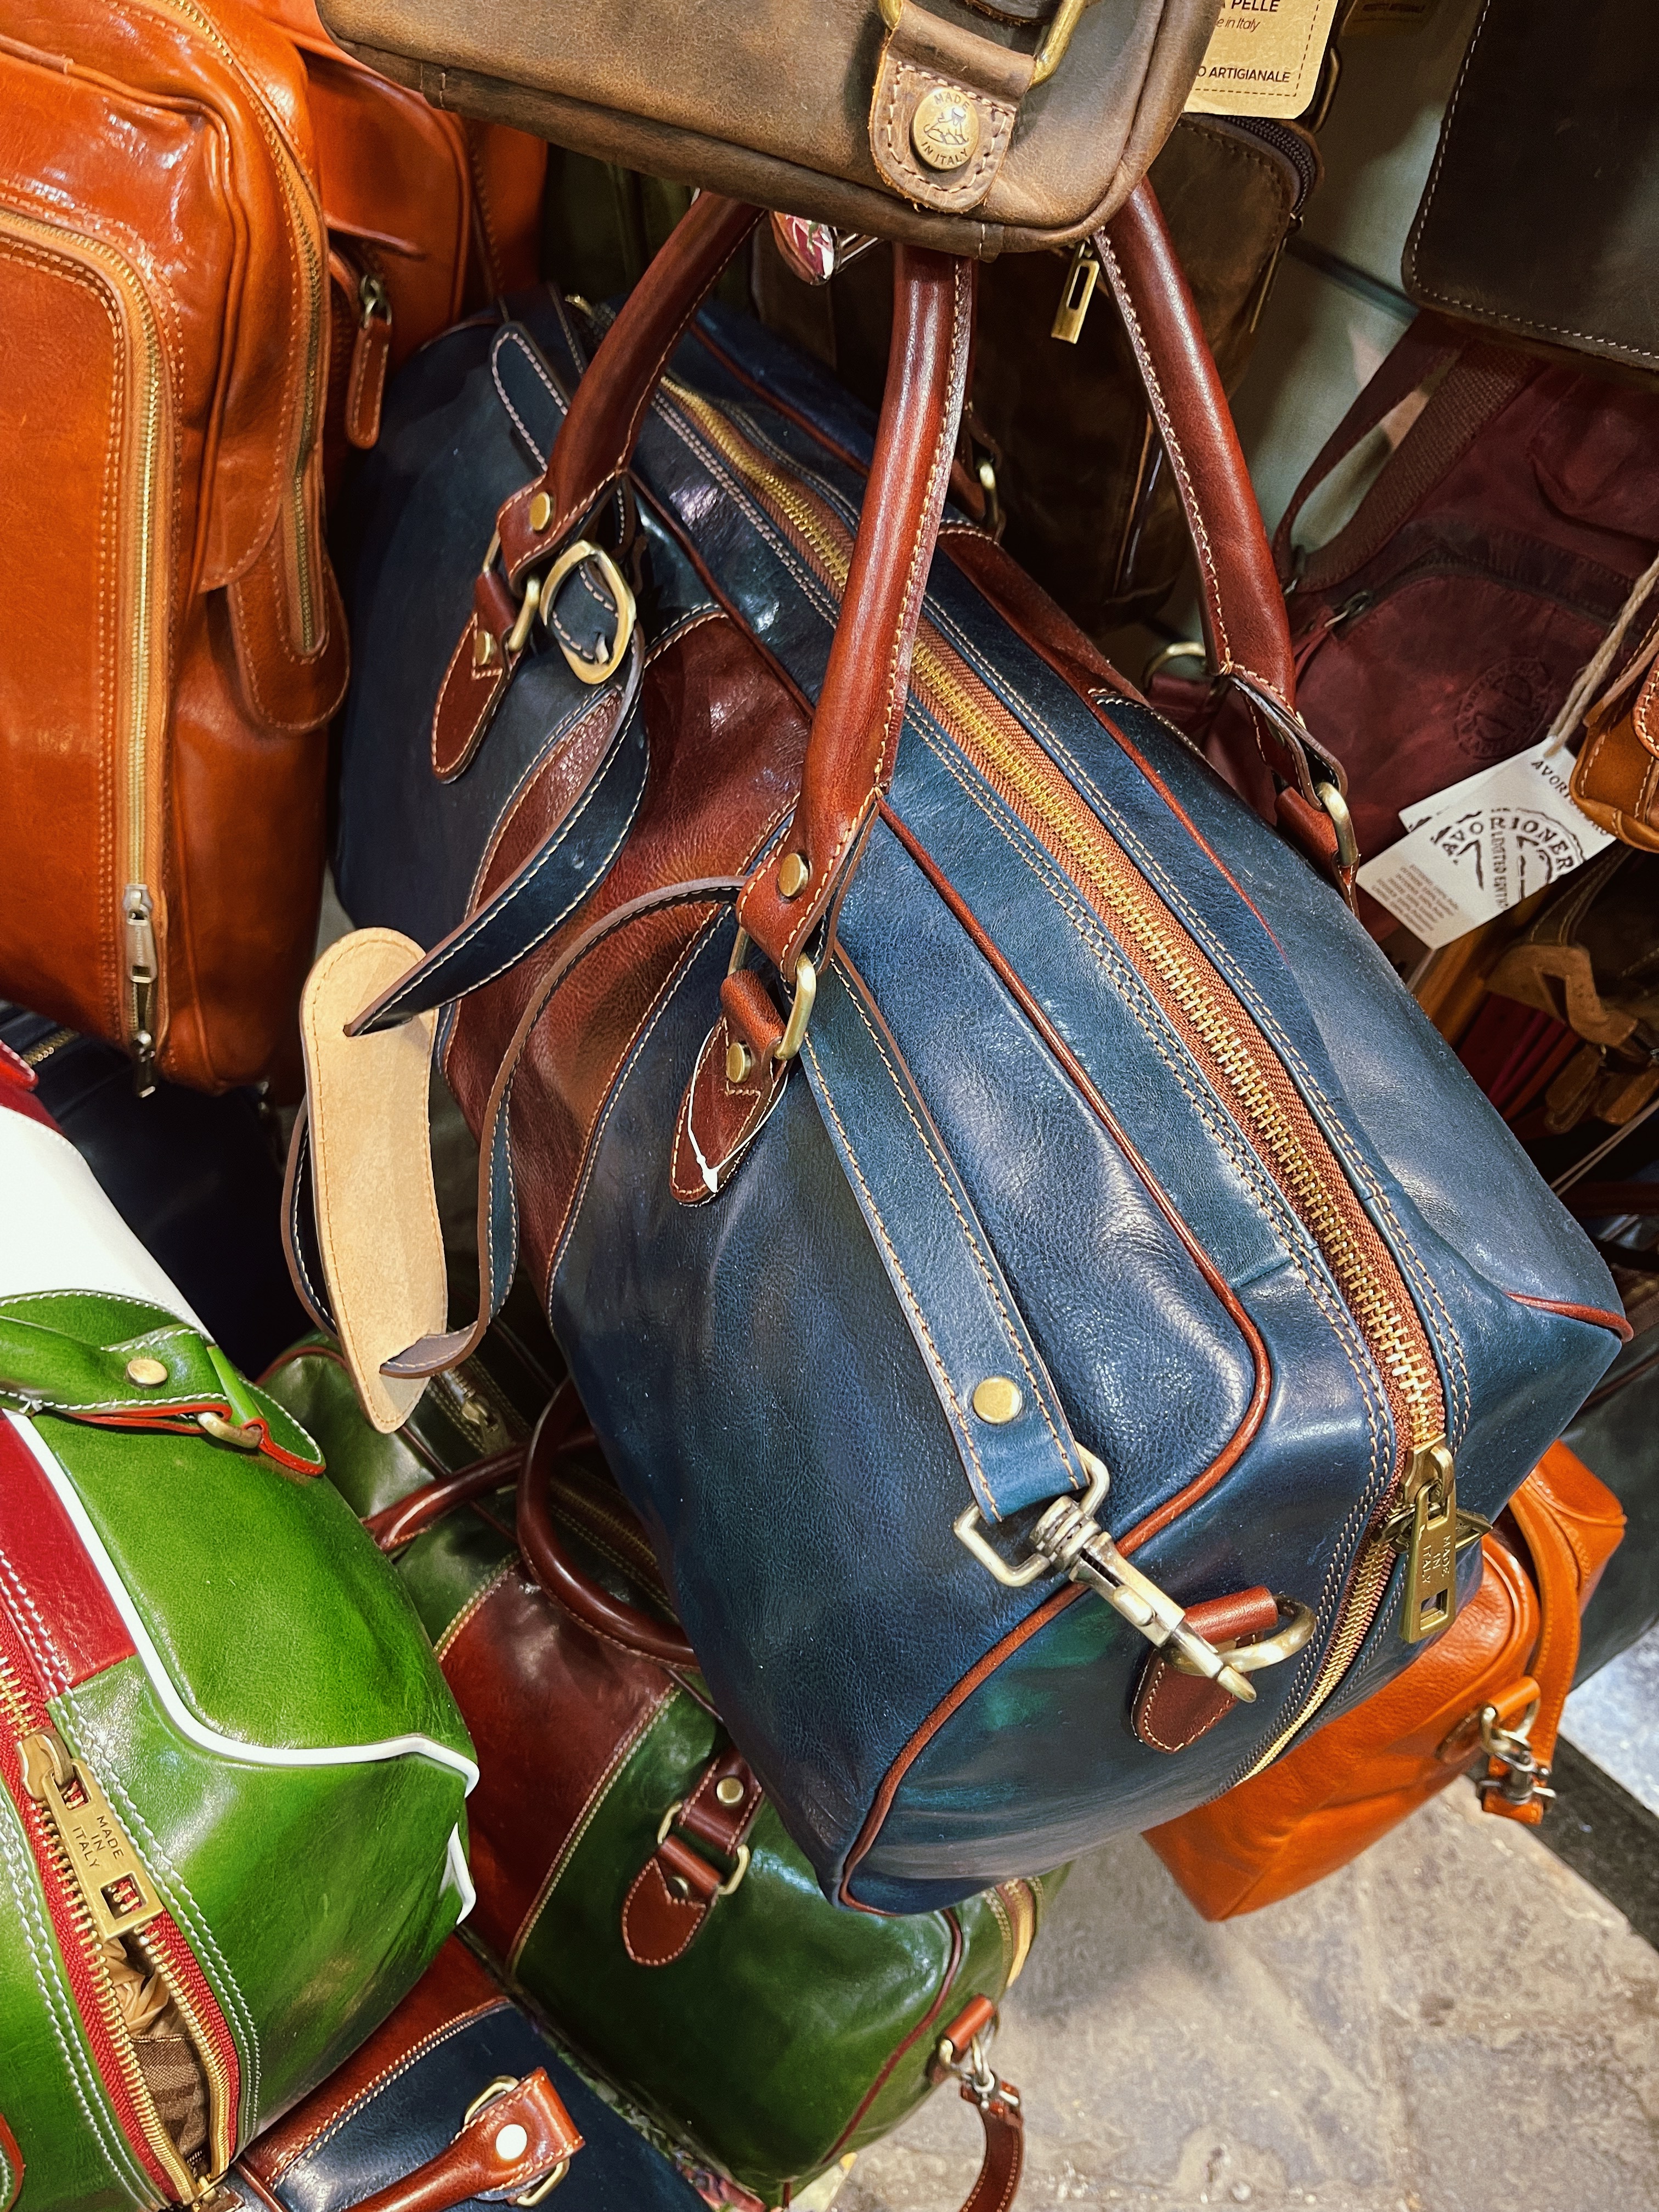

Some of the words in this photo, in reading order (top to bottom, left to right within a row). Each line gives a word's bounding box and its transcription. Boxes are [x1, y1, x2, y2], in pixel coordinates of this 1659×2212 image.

[1231, 0, 1280, 12] PELLE
[1225, 16, 1235, 29] in
[1236, 18, 1261, 33] Italy
[1208, 66, 1291, 83] ARTIGIANALE
[934, 92, 970, 112] MADE
[921, 142, 933, 156] IN
[933, 148, 968, 165] ITALY
[1422, 1545, 1431, 1583] ITALY
[1432, 1553, 1441, 1569] IN
[1441, 1534, 1451, 1578] MADE
[72, 1826, 100, 1867] ITALY
[91, 1834, 106, 1852] IN
[97, 1815, 125, 1860] MADE
